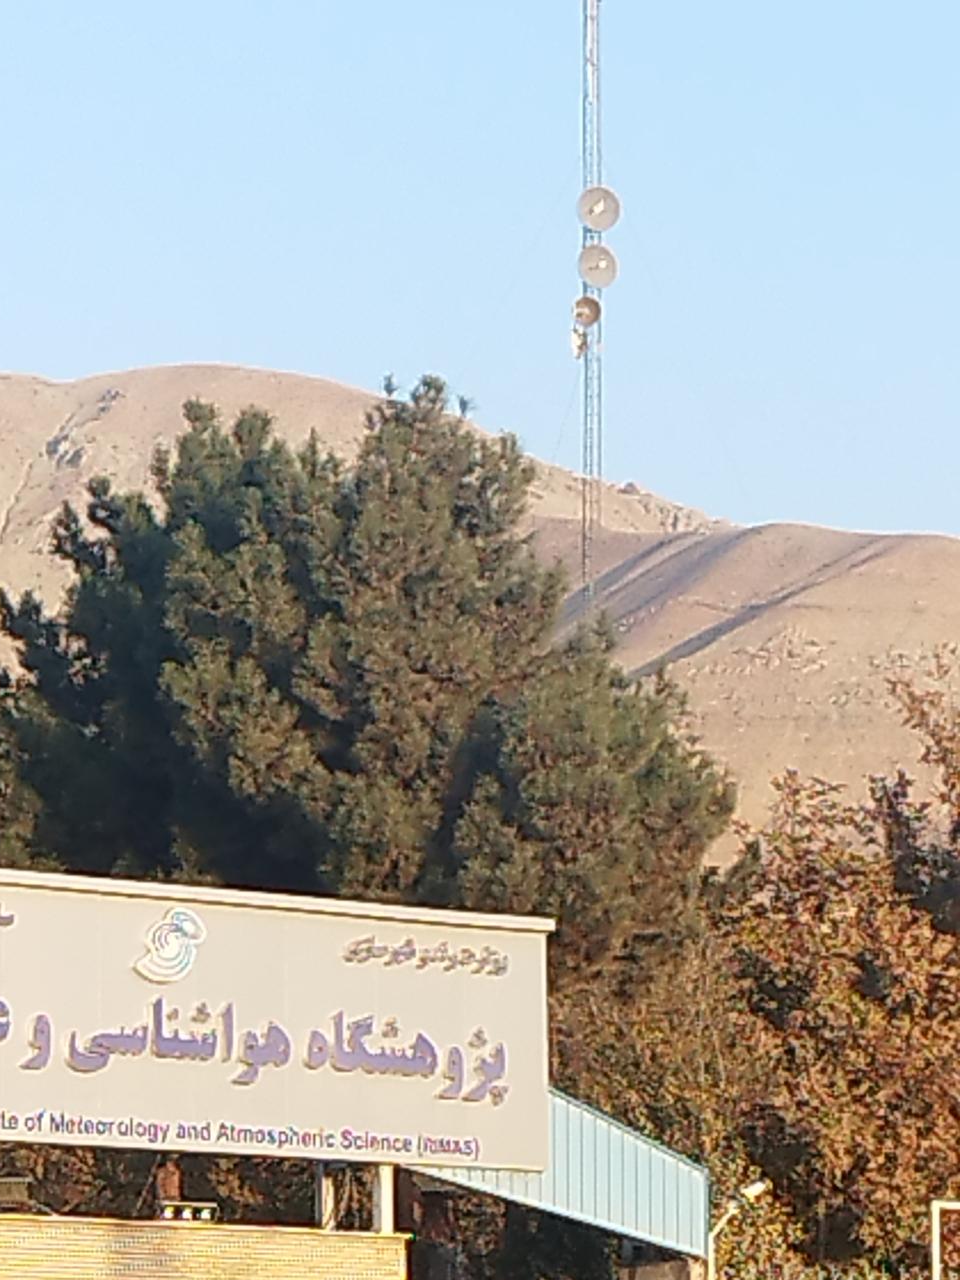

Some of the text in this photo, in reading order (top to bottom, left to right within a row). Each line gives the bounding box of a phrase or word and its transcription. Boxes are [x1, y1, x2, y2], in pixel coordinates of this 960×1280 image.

[18, 1013, 52, 1071] و
[64, 995, 292, 1086] هواشناسی
[302, 1009, 509, 1106] پژوهشگاه
[24, 1108, 46, 1132] of
[49, 1113, 171, 1143] Meteorology
[176, 1121, 211, 1142] and
[216, 1121, 336, 1149] Atmospheric
[340, 1128, 413, 1152] Science
